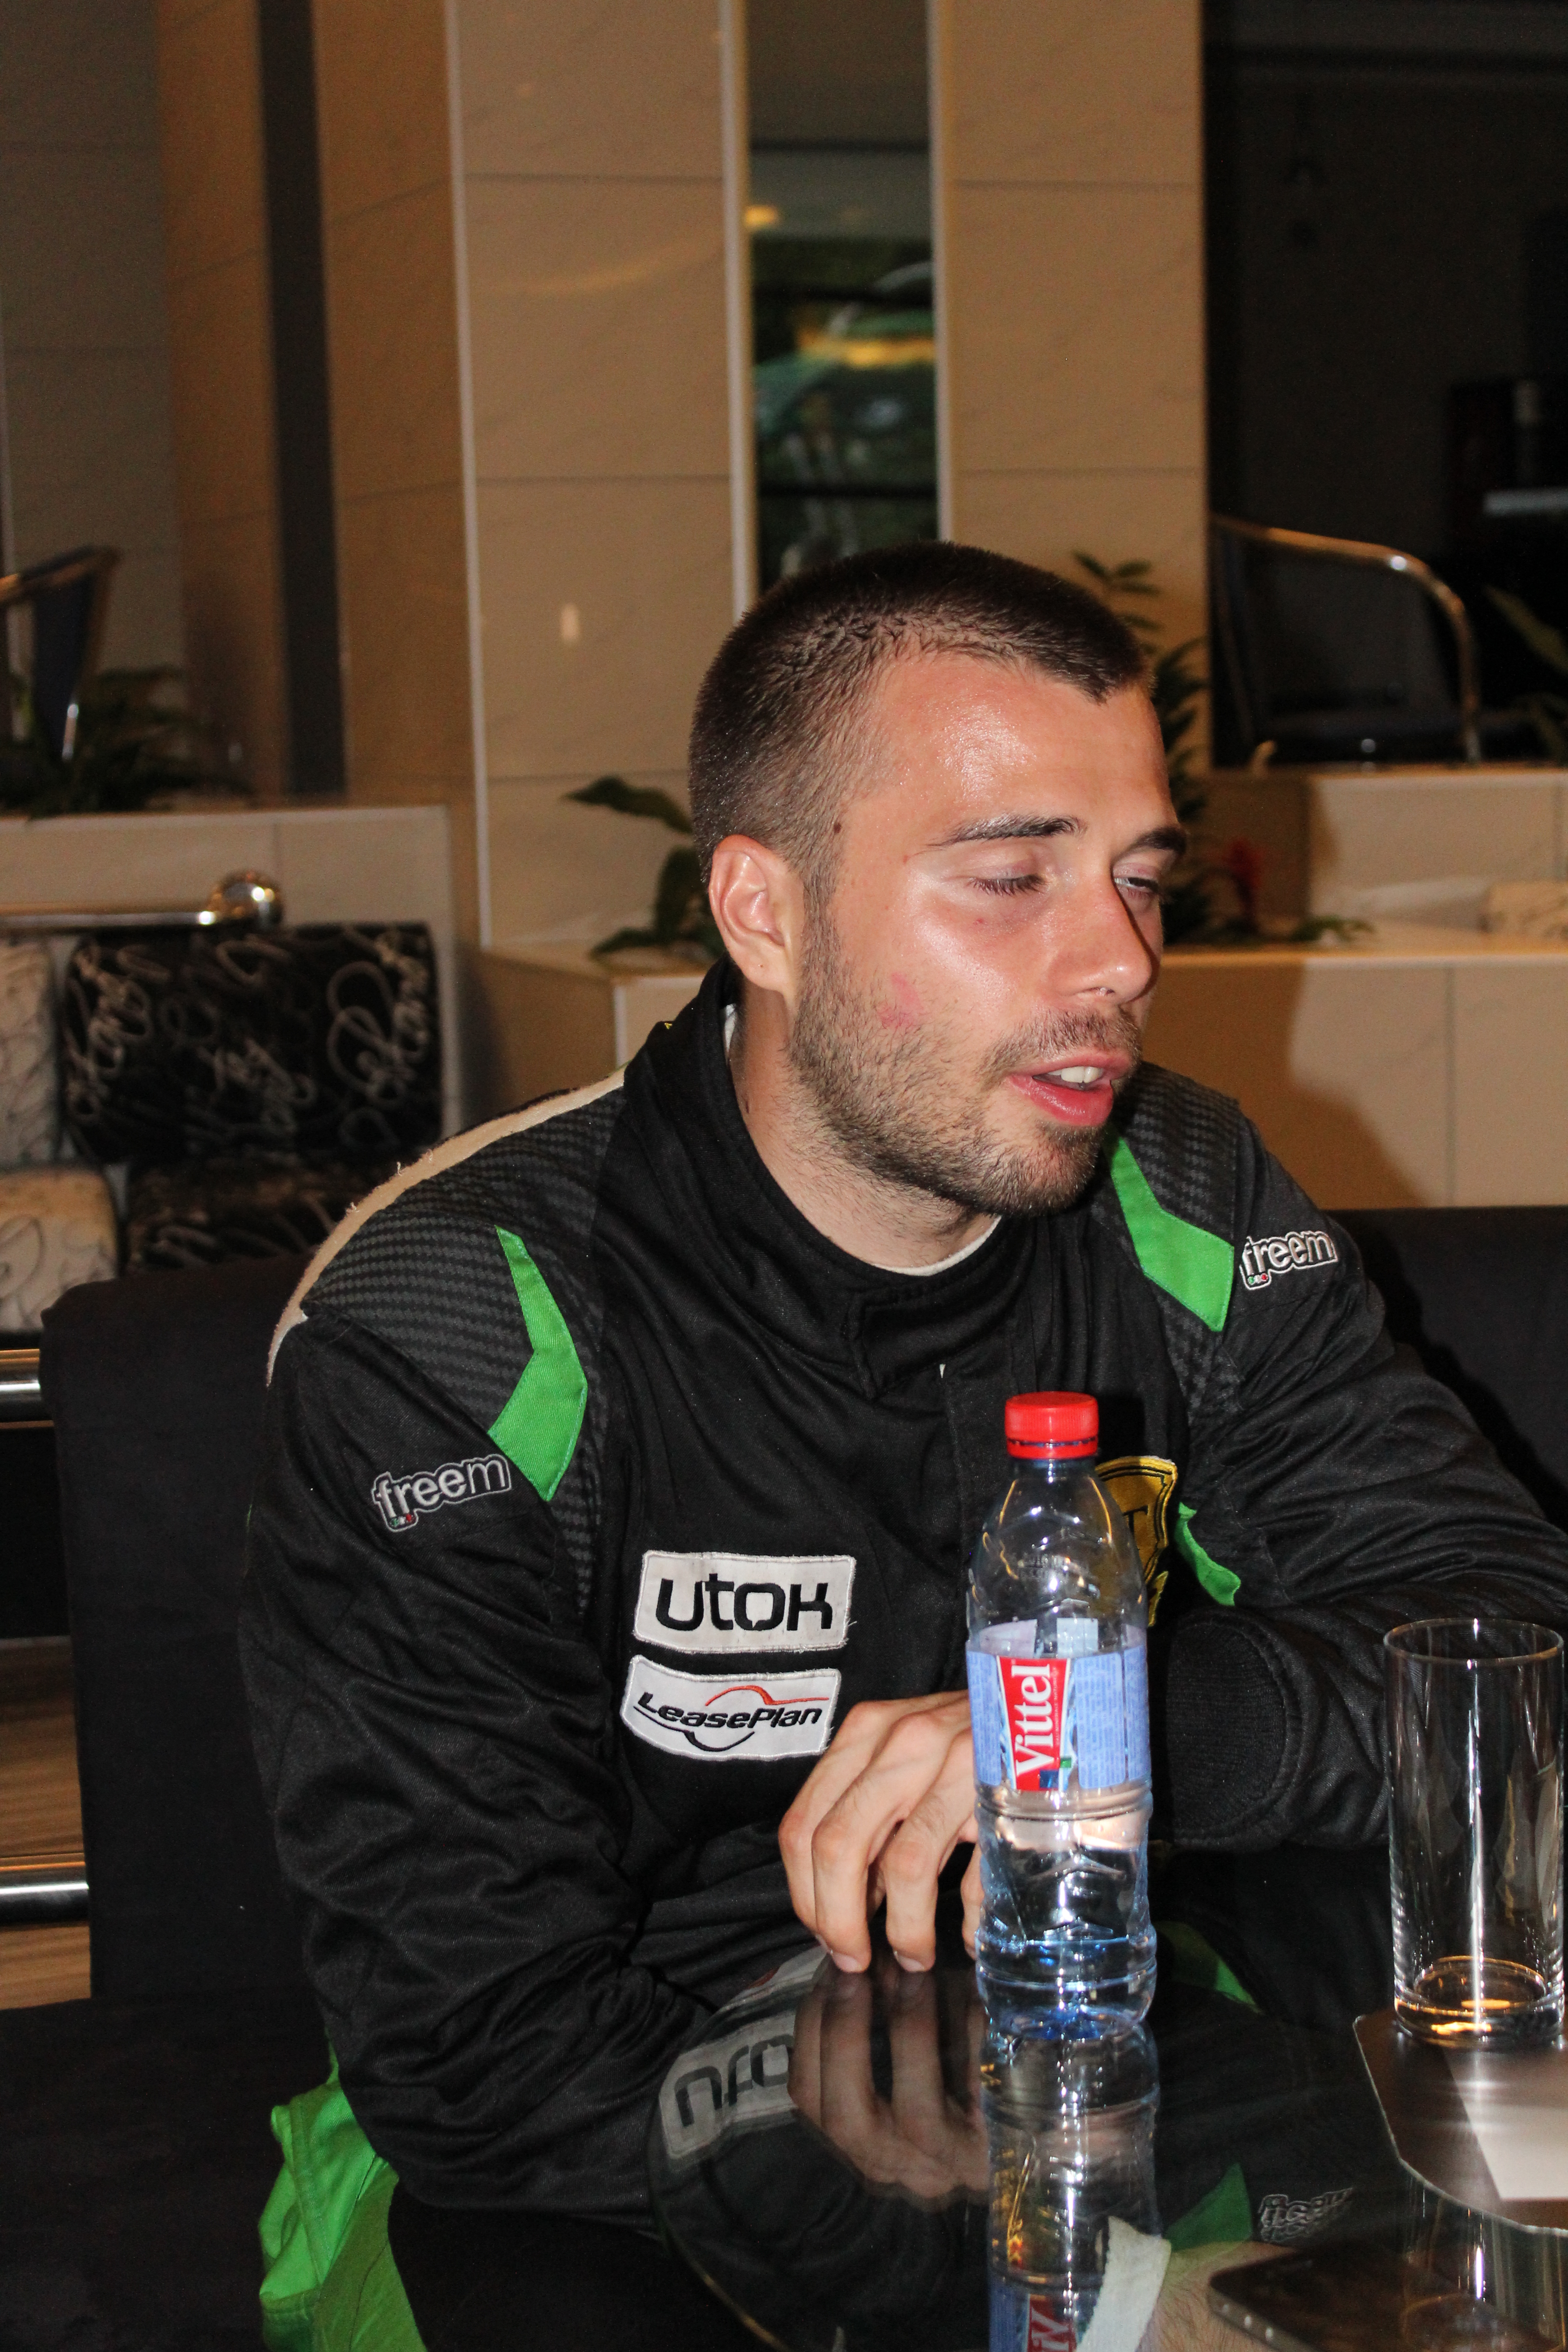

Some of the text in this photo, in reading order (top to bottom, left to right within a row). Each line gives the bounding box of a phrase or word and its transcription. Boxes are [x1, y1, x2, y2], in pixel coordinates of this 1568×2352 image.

[1242, 1235, 1333, 1275] freem
[376, 1459, 506, 1518] freem
[637, 1691, 823, 1729] LeasePlan
[1011, 1664, 1055, 1776] Vittel
